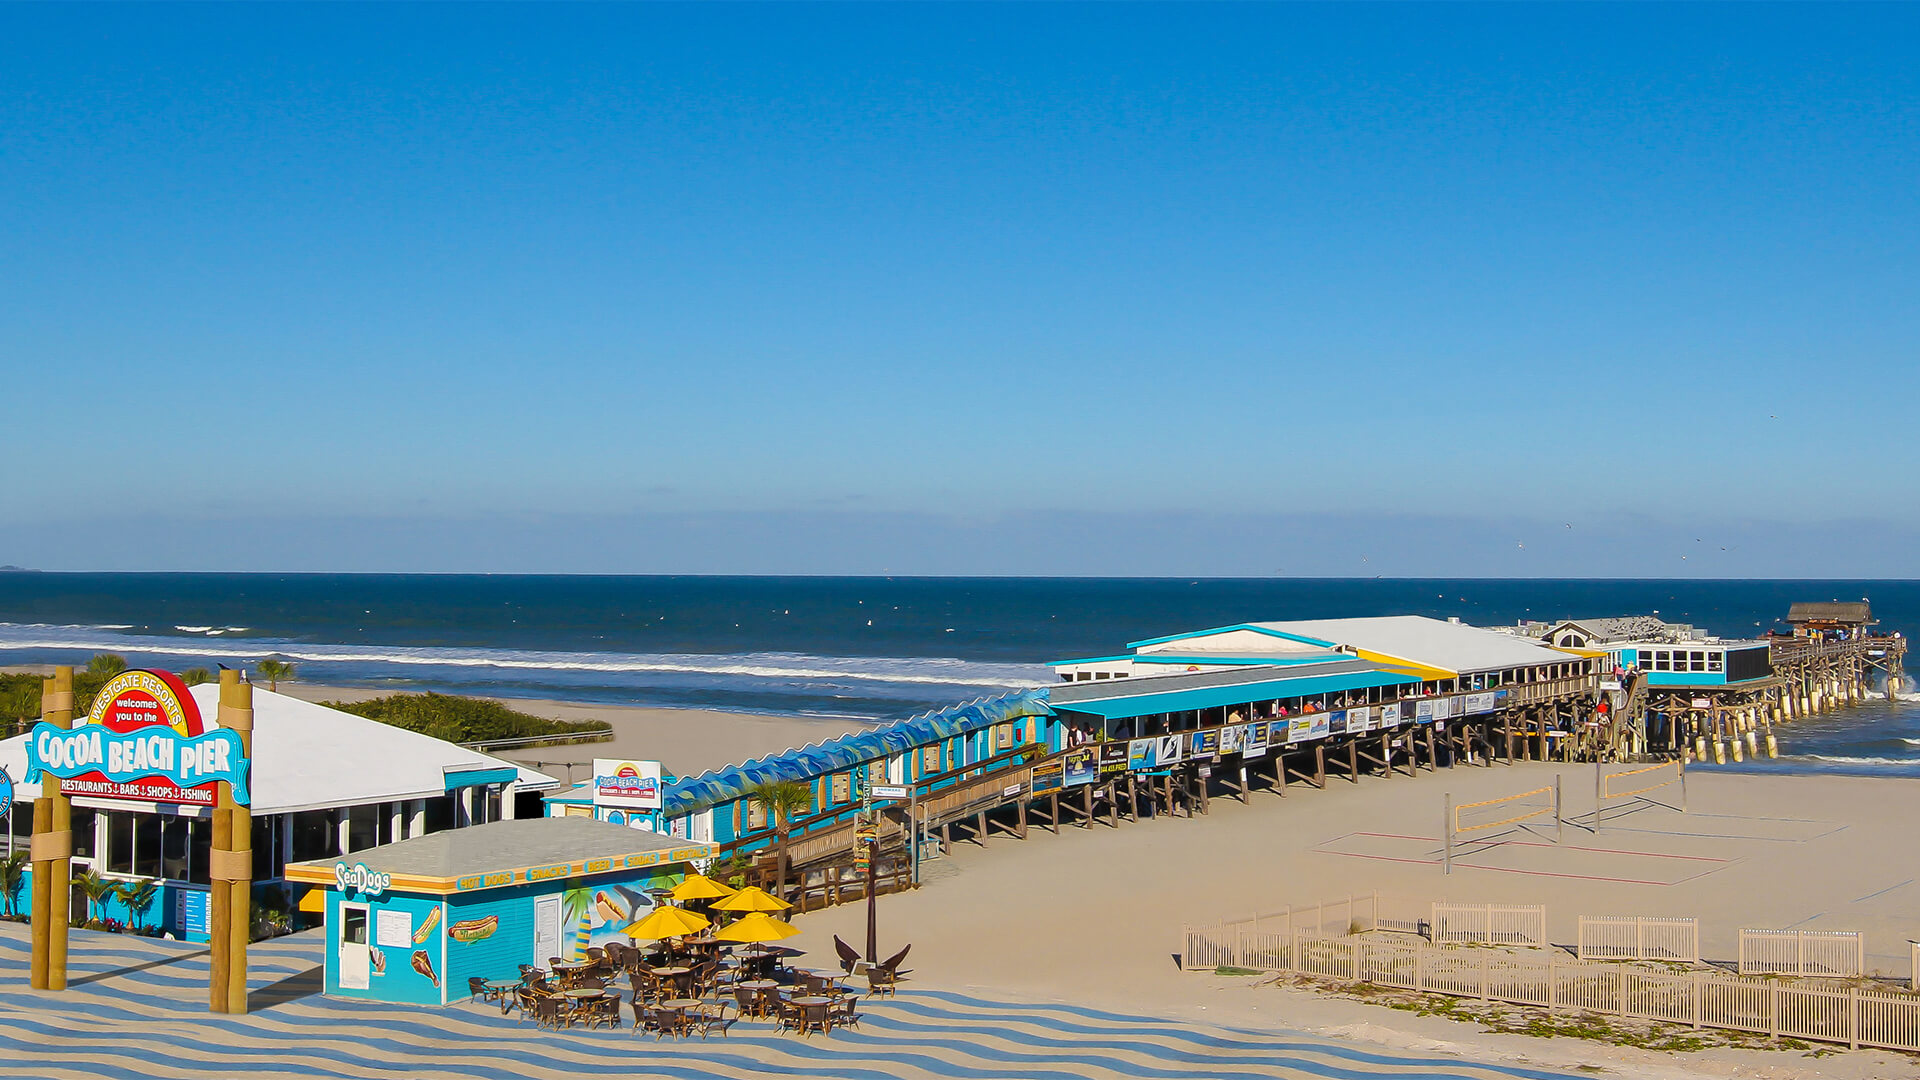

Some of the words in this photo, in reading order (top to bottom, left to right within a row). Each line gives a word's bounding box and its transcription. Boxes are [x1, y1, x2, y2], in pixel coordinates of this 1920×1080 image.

[92, 675, 139, 720] WESTGATE
[142, 676, 182, 725] RESORTS
[116, 698, 158, 709] welcomes
[116, 713, 132, 722] you
[134, 712, 142, 721] to
[144, 712, 157, 722] the
[38, 731, 103, 769] COCOA
[108, 735, 174, 774] BEACH
[180, 738, 231, 779] PIER
[618, 778, 638, 787] BEACH
[639, 779, 654, 788] PIER
[61, 779, 113, 794] RESTAURANTS
[120, 783, 140, 796] BARS
[147, 786, 173, 799] SHOPS
[180, 788, 212, 801] FISHING
[672, 847, 708, 860] RENTALS
[587, 860, 610, 872] BEER
[627, 854, 656, 867] SODAS
[531, 865, 568, 880] SNACKS
[460, 877, 481, 889] HOT
[484, 873, 511, 887] DOGS
